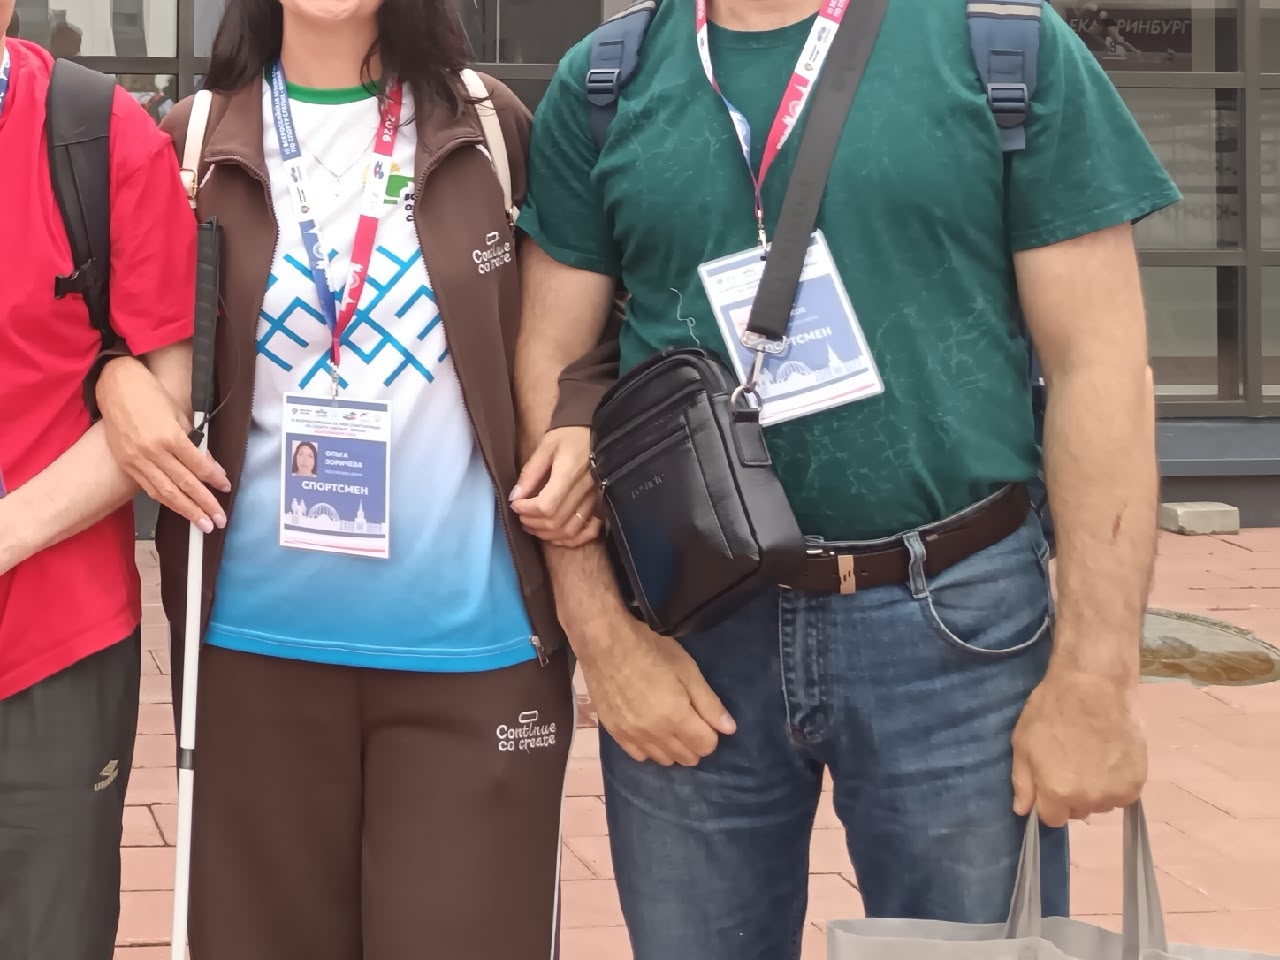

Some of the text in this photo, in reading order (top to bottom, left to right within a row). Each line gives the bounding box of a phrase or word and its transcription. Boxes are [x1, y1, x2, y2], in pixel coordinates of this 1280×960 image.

[1069, 18, 1192, 35] ЕКАРИНБУРГ
[301, 480, 369, 496] СПОРТСМЕН
[496, 722, 557, 740] Continue
[518, 734, 557, 754] create
